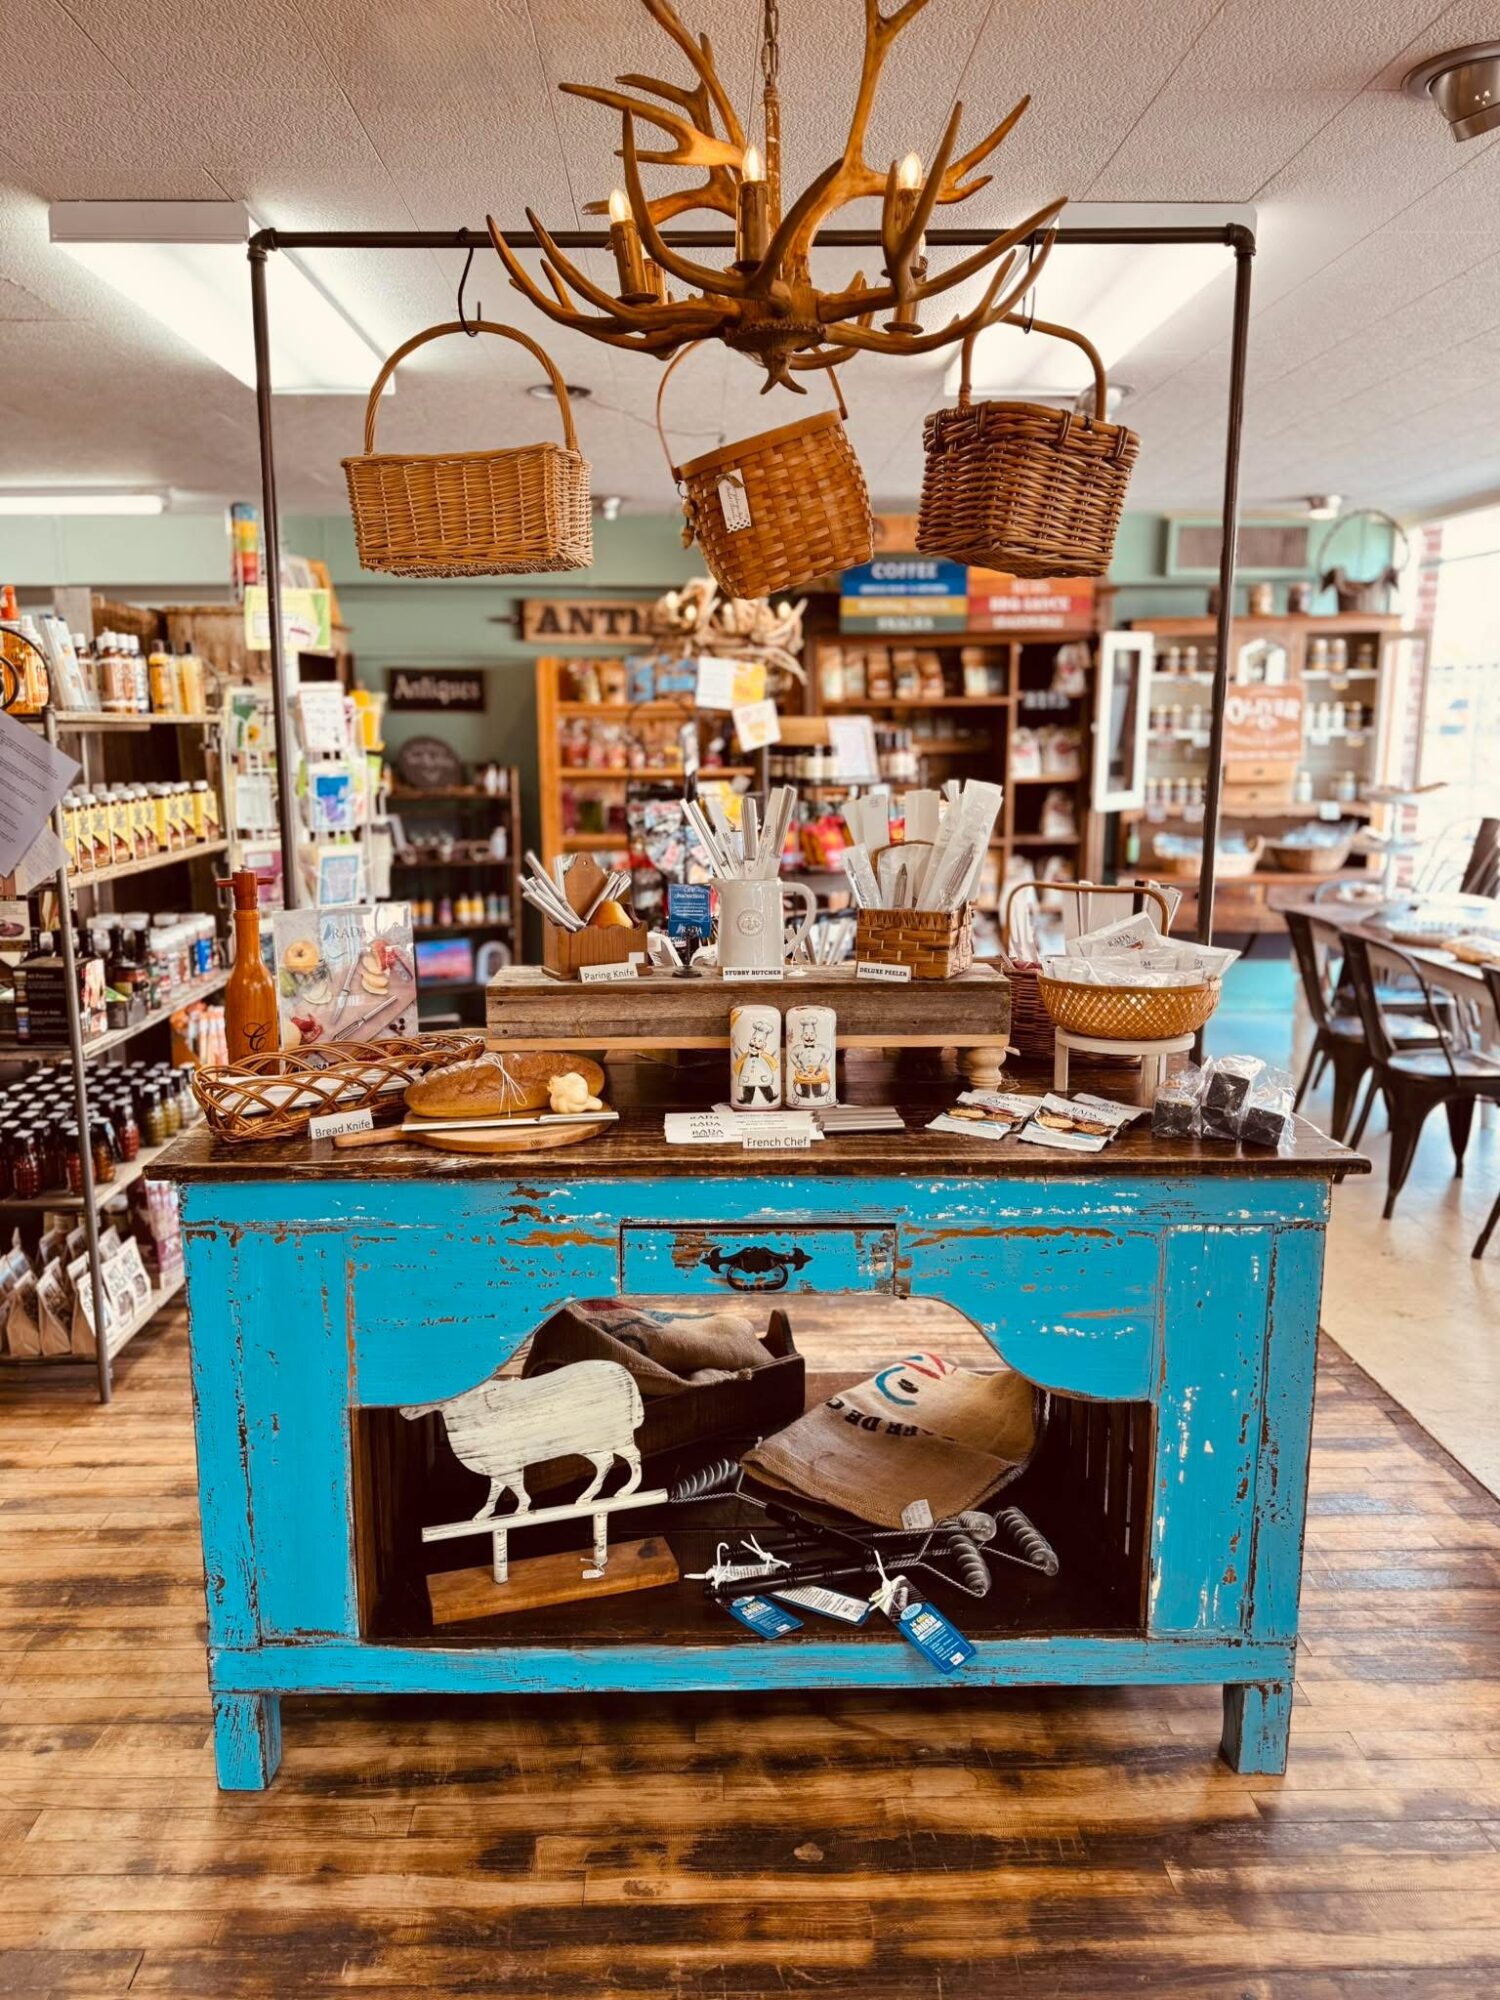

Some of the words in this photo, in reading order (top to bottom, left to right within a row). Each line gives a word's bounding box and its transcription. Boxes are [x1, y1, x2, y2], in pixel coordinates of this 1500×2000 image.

[871, 562, 938, 580] COFFEE
[536, 605, 648, 635] ANTI
[584, 971, 612, 982] Paring
[613, 969, 635, 978] Knife
[859, 967, 883, 975] DELUXE
[884, 969, 907, 977] PEELER
[315, 1123, 344, 1137] Bread
[346, 1119, 371, 1132] Knife
[747, 1137, 781, 1147] French
[784, 1136, 807, 1146] Chef
